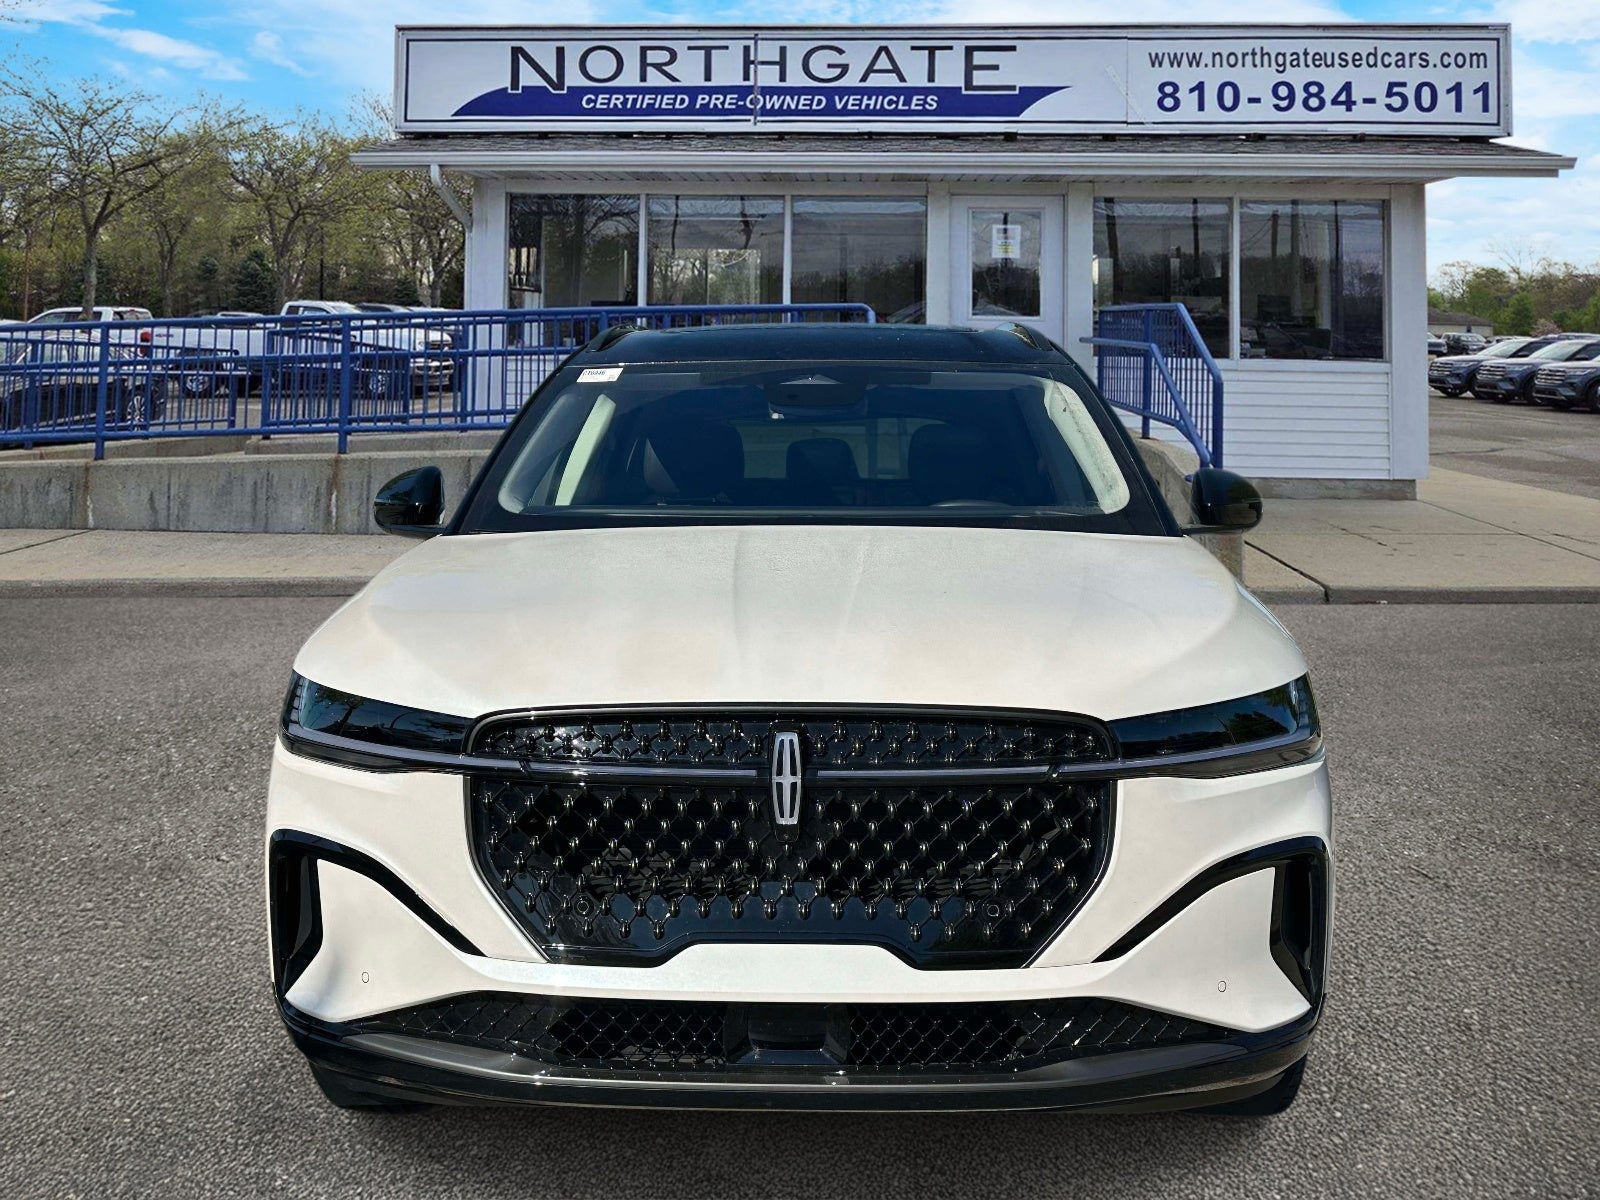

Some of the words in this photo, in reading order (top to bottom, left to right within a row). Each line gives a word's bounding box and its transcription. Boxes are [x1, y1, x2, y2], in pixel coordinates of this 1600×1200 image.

[510, 44, 1017, 92] NORTHGATE
[1148, 46, 1488, 73] www.northgateusedcars.com
[581, 94, 689, 110] CERTIFIED
[695, 94, 826, 110] PRE-OWNED
[834, 95, 938, 110] VEHICLES
[1156, 80, 1491, 113] 810-984-5011
